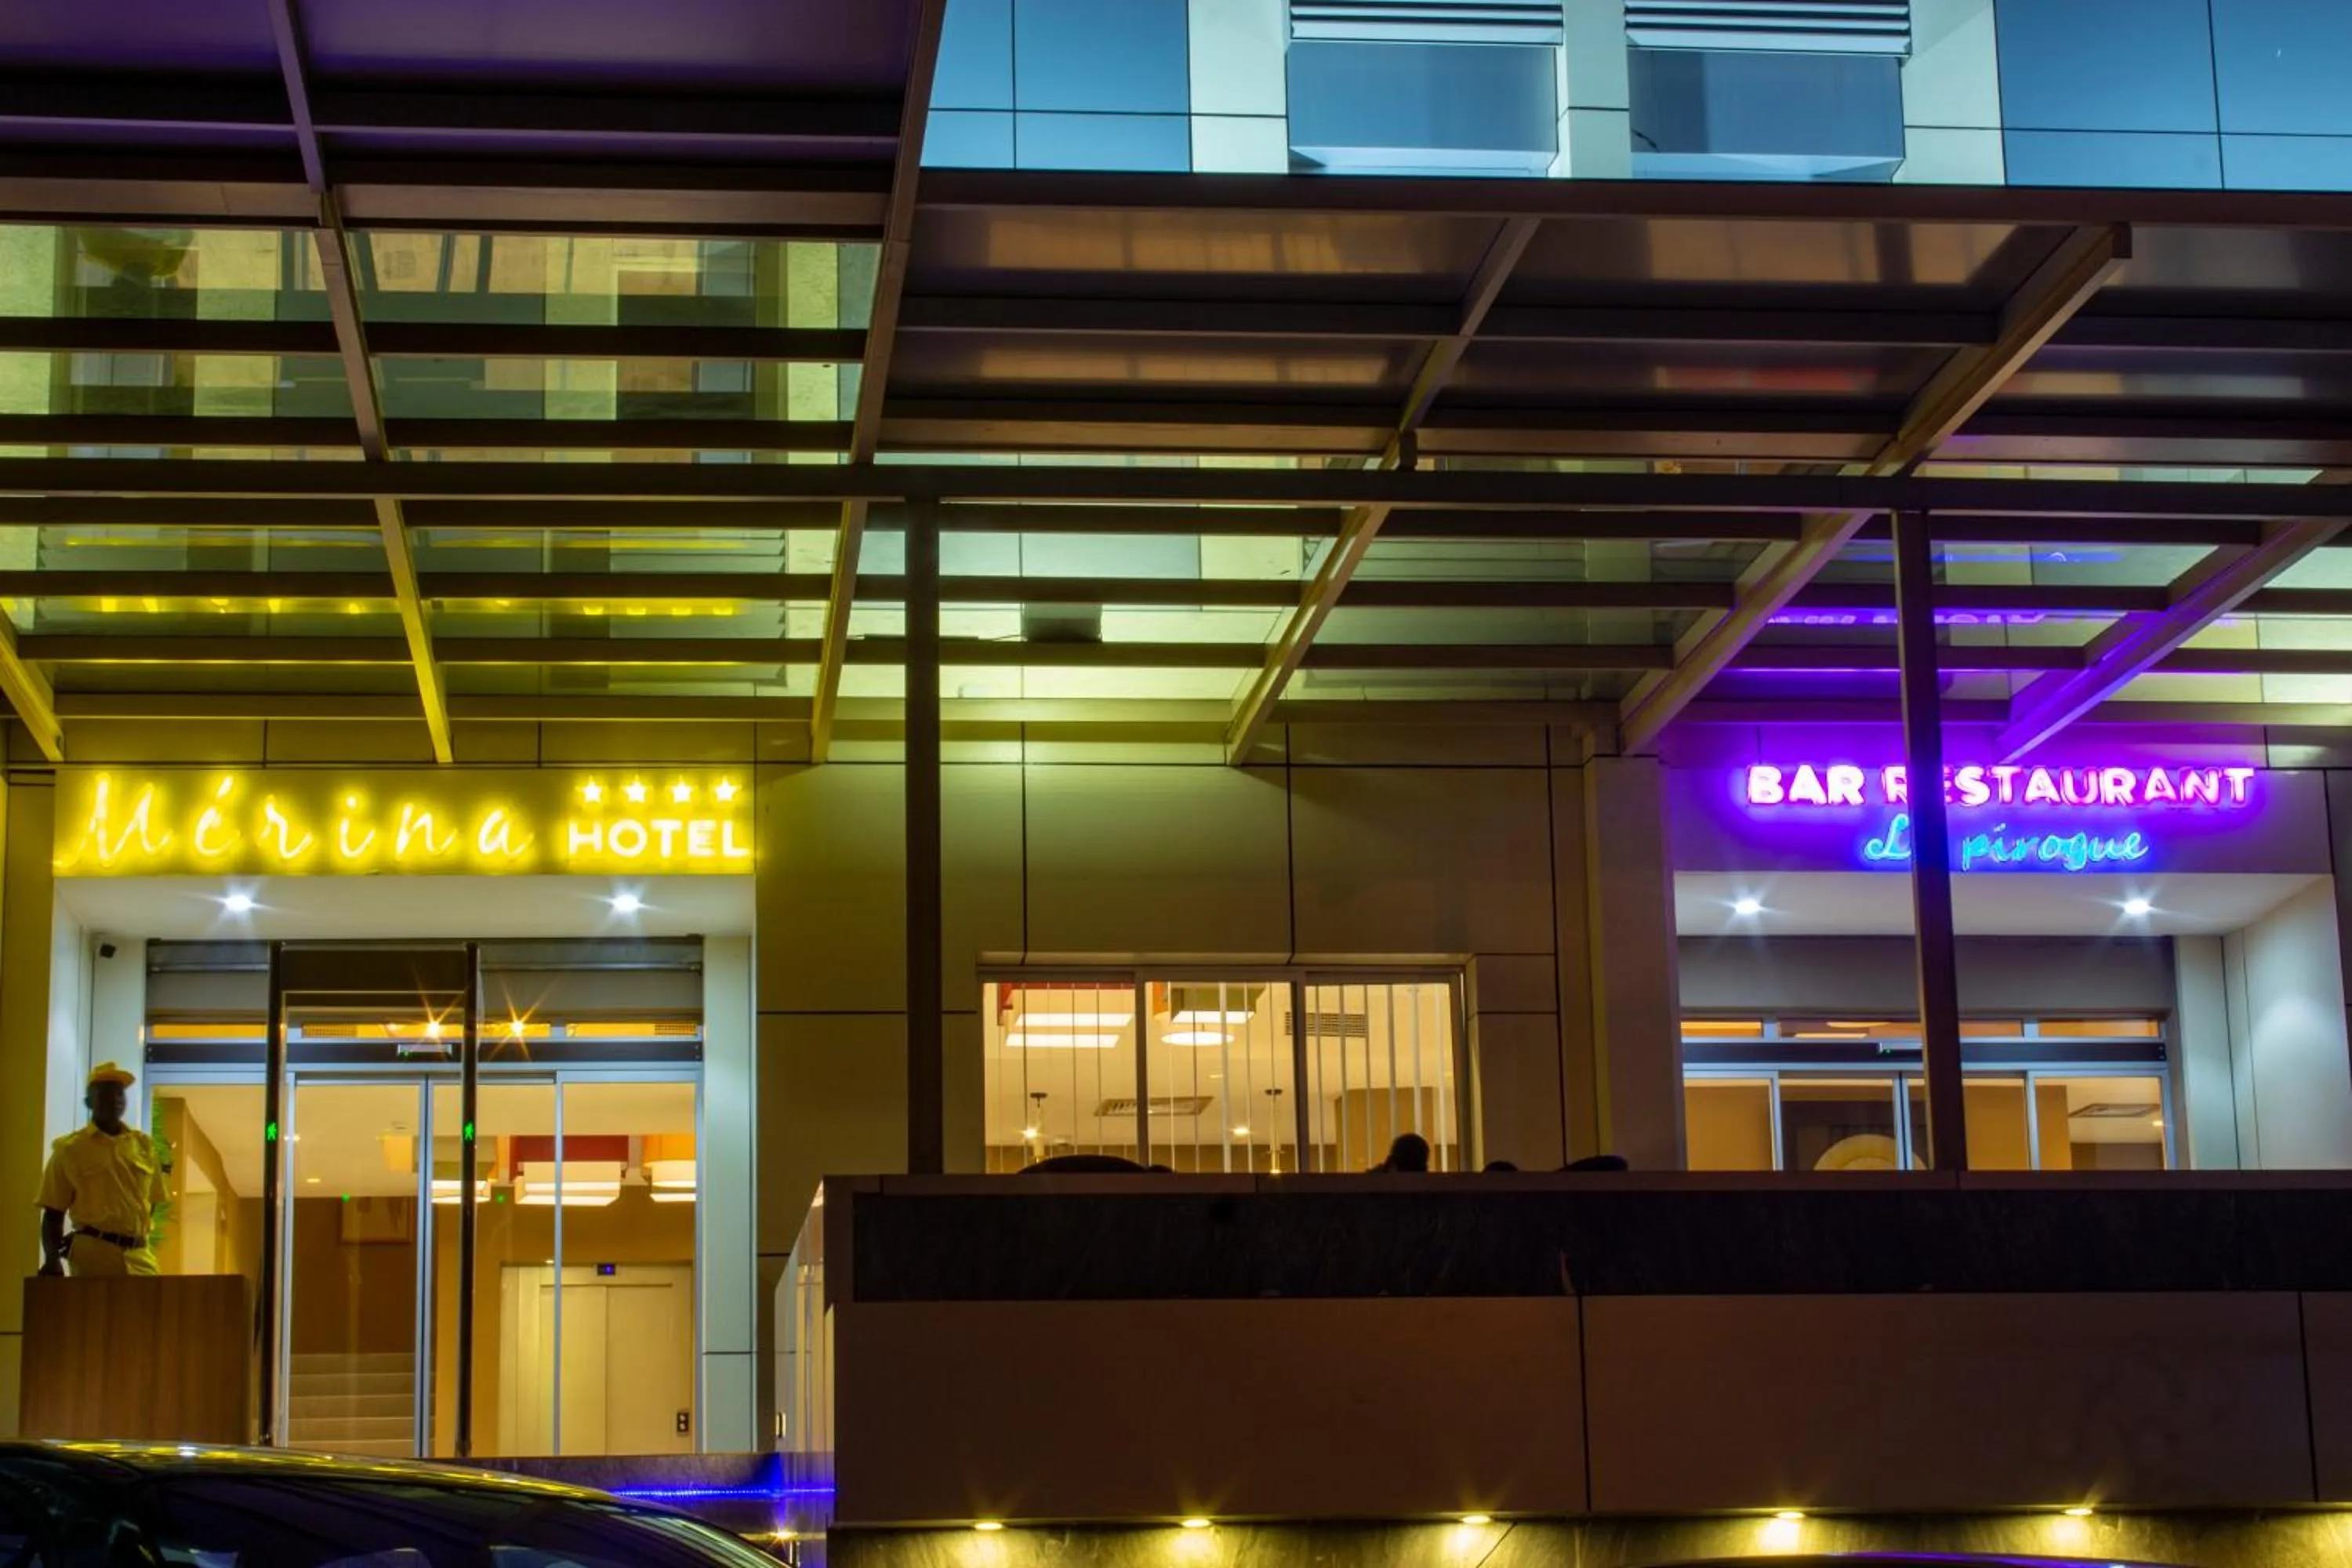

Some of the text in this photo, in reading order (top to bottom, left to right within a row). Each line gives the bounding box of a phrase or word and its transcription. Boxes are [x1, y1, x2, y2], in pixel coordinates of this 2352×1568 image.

[1747, 764, 1865, 806] BAR
[55, 772, 750, 866] Mérina HOTEL
[1962, 823, 2149, 872] pirogue
